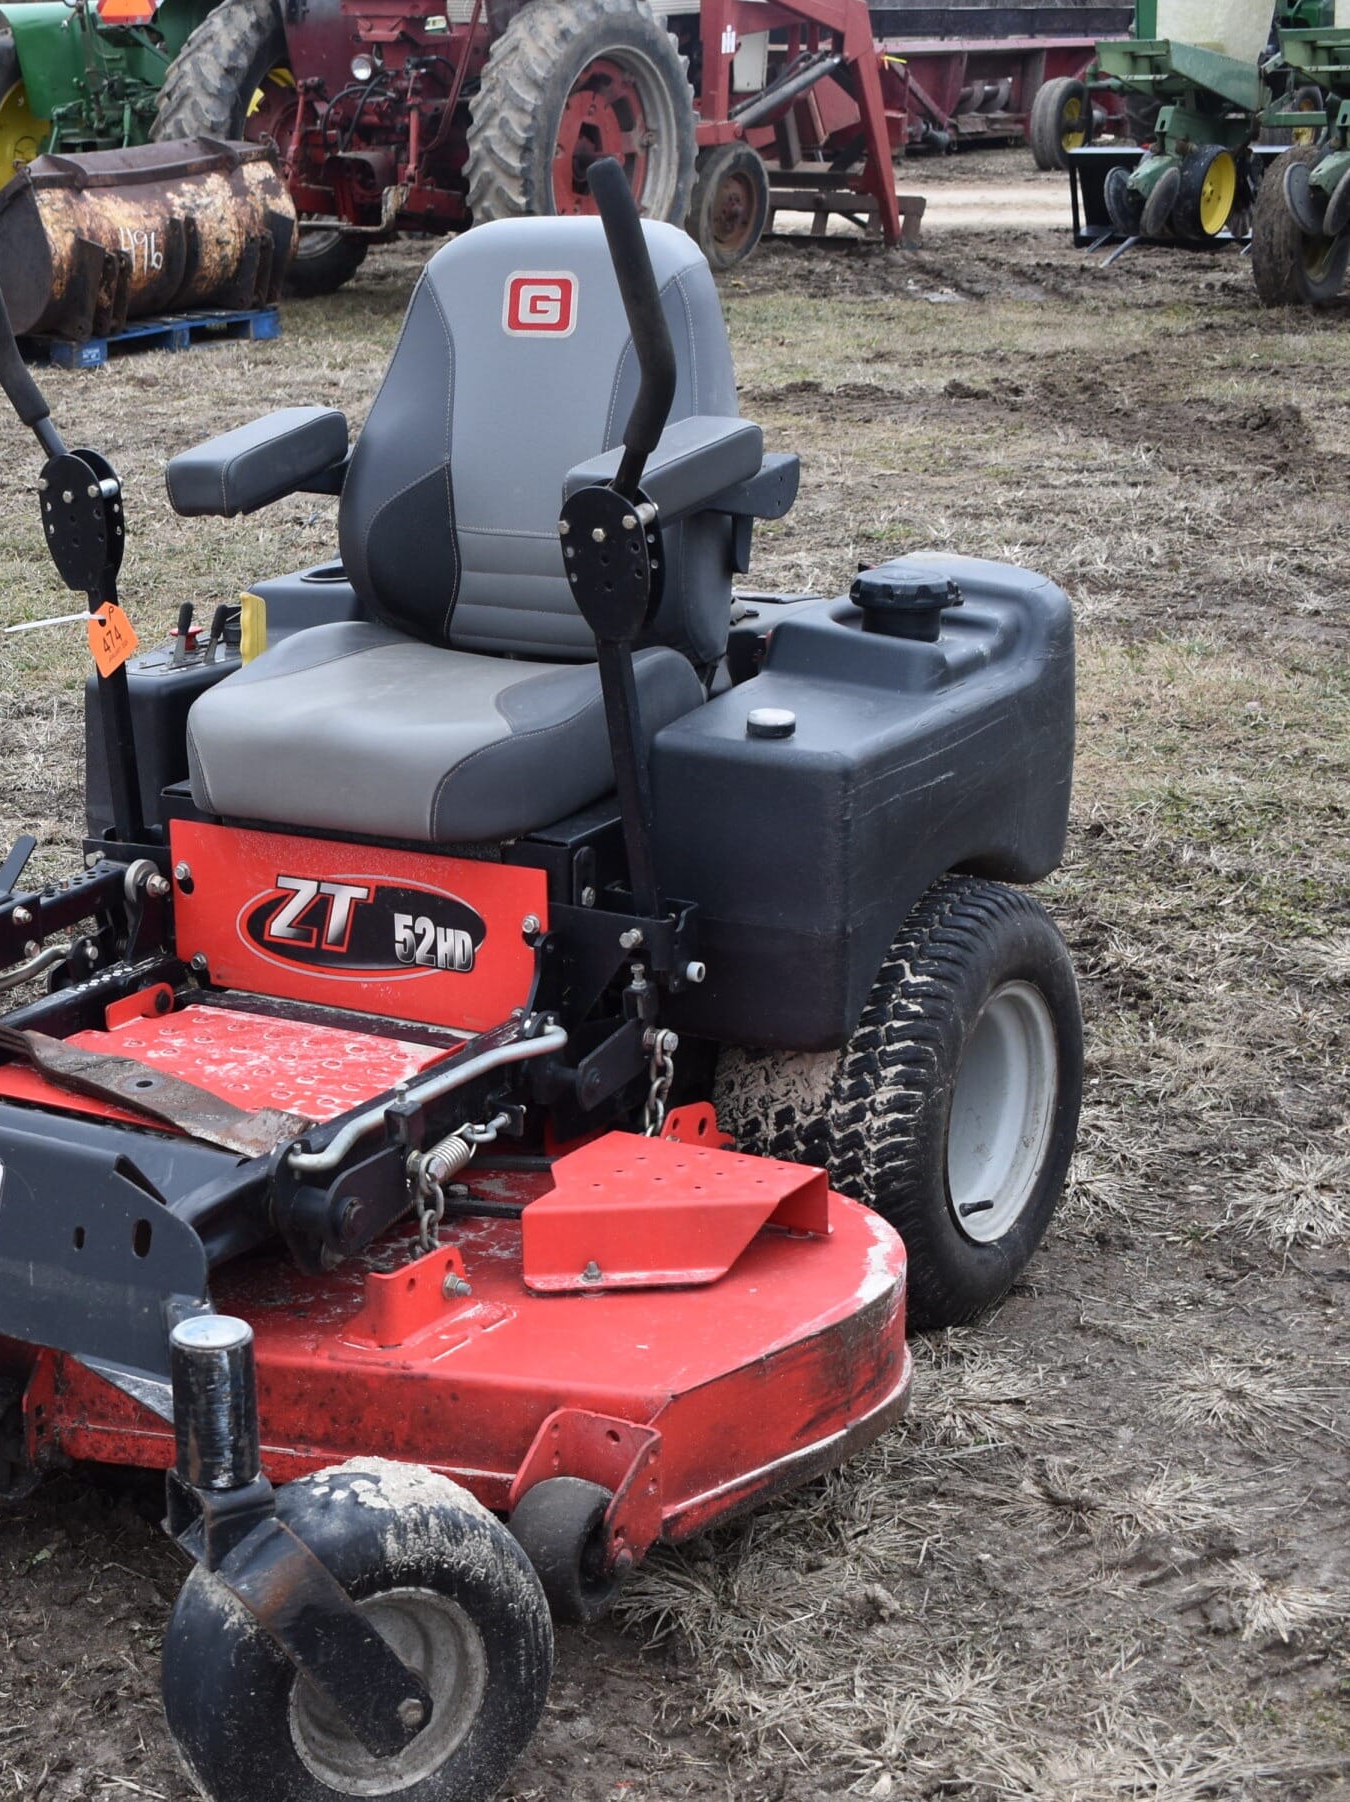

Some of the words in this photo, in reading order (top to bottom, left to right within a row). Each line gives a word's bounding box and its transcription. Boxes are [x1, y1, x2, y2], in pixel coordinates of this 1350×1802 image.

[119, 227, 163, 274] 496
[518, 285, 562, 324] G
[103, 625, 123, 653] 474
[268, 875, 370, 948] ZT
[393, 912, 475, 972] 52HD
